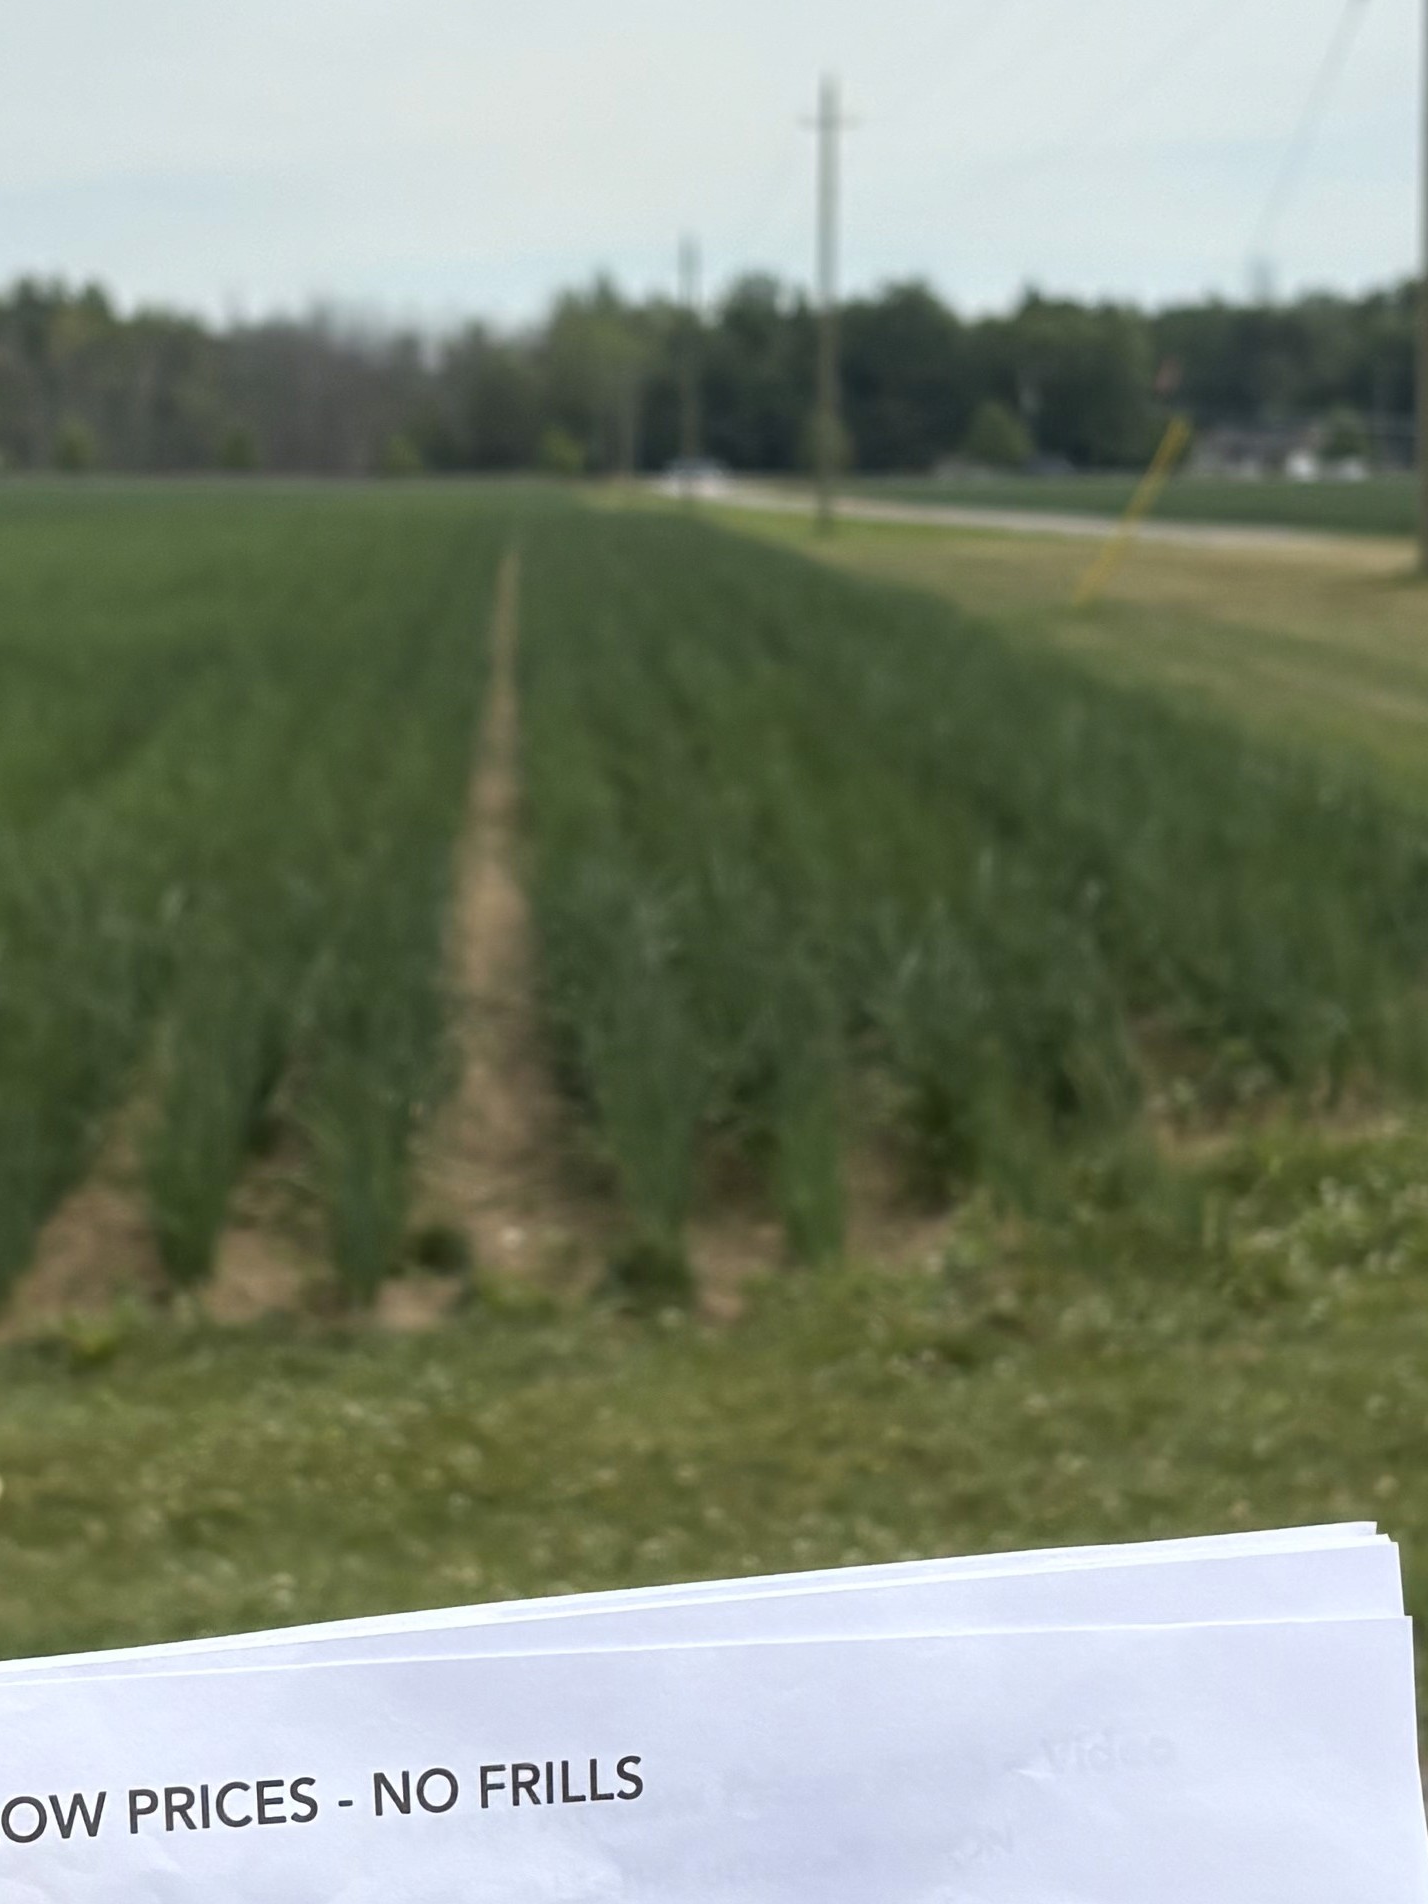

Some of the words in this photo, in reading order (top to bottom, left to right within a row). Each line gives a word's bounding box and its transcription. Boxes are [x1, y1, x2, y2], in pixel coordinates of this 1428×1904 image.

[128, 1776, 319, 1835] PRICES
[373, 1767, 459, 1817] NO
[479, 1755, 644, 1809] FRILLS
